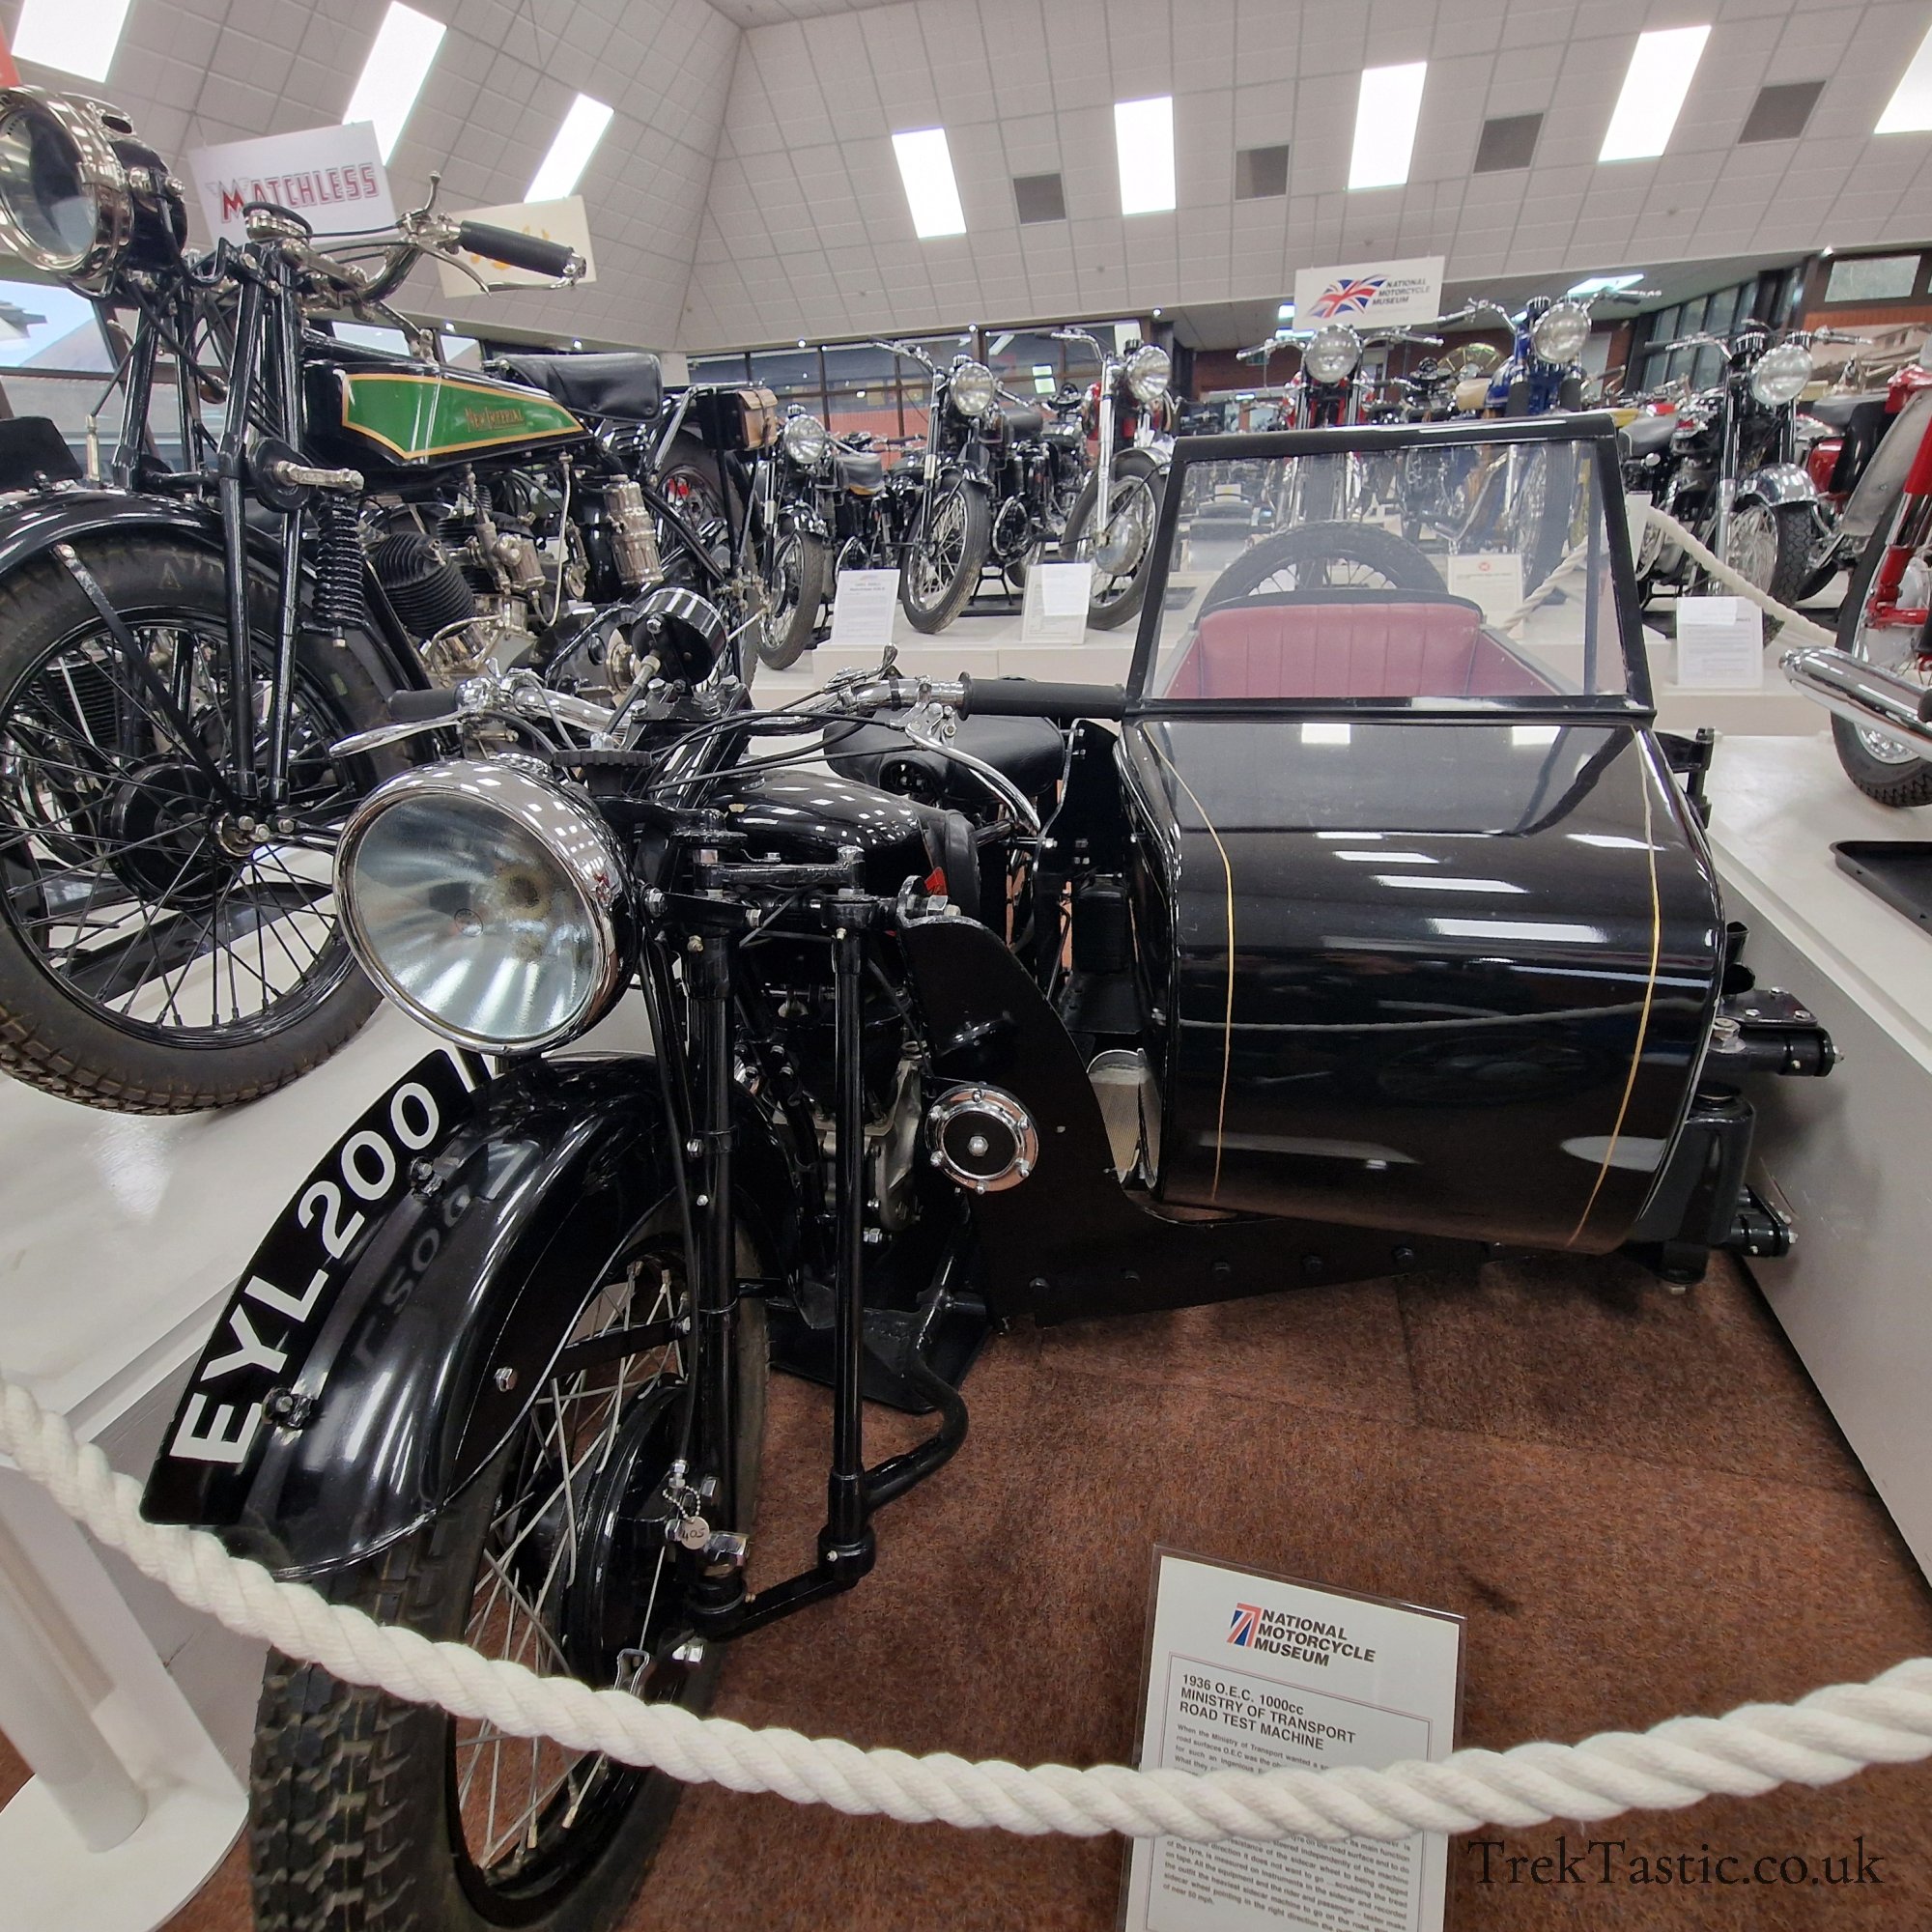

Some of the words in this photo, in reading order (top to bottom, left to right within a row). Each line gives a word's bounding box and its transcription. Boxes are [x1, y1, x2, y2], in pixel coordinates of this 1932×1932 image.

[218, 162, 379, 223] MATCHLESS
[1372, 297, 1409, 306] MUSEUM
[1378, 286, 1431, 298] MOTORCYCLE
[1386, 278, 1427, 289] NATIONAL
[1259, 1623, 1376, 1662] MOTORCYCLE
[1263, 1609, 1348, 1640] NATIONAL
[1254, 1637, 1330, 1666] MUSEUM
[1182, 1674, 1211, 1690] 1936
[1215, 1682, 1254, 1703] O.E.C.
[1260, 1694, 1304, 1716] 1000cc
[1179, 1701, 1218, 1720] ROAD
[1222, 1712, 1257, 1731] TEST
[1260, 1723, 1324, 1750] MACHINE
[1180, 1688, 1243, 1713] MINISTRY
[1247, 1705, 1265, 1719] OF
[1270, 1710, 1356, 1744] TRANSPORT
[1175, 1755, 1191, 1766] What
[1193, 1760, 1208, 1772] they
[1177, 1735, 1192, 1745] road
[1193, 1740, 1221, 1752] surfaces
[1244, 1754, 1257, 1763] was
[1260, 1758, 1270, 1767] the
[1178, 1724, 1196, 1735] When
[1199, 1729, 1208, 1738] the
[1212, 1733, 1237, 1747] Ministry
[1251, 1745, 1283, 1759] Transport
[1286, 1755, 1311, 1766] wanted
[1188, 1749, 1205, 1758] such
[1301, 1848, 1350, 1868] independently
[1364, 1866, 1376, 1875] the
[1378, 1871, 1408, 1885] machine
[1329, 1845, 1346, 1855] road
[1348, 1851, 1374, 1863] surface
[1360, 1843, 1378, 1853] main
[1380, 1847, 1409, 1862] function
[1165, 1861, 1176, 1870] the
[1199, 1872, 1209, 1881] the
[1211, 1876, 1239, 1890] heaviest
[1243, 1887, 1267, 1899] sidecar
[1270, 1895, 1301, 1910] machine
[1338, 1916, 1350, 1925] the
[1172, 1887, 1186, 1895] near
[1176, 1842, 1186, 1851] the
[1214, 1856, 1248, 1870] measured
[1262, 1870, 1303, 1888] instruments
[1316, 1887, 1326, 1895] the
[1329, 1891, 1354, 1903] sidecar
[1358, 1900, 1371, 1909] and
[1375, 1905, 1406, 1919] recorded
[1206, 1862, 1216, 1871] the
[1218, 1867, 1254, 1884] equipment
[1256, 1880, 1268, 1889] and
[1270, 1884, 1282, 1892] the
[1284, 1888, 1299, 1897] rider
[1302, 1893, 1315, 1903] and
[1211, 1843, 1240, 1858] direction
[1251, 1856, 1267, 1865] does
[1271, 1861, 1282, 1870] not
[1285, 1866, 1301, 1876] want
[1375, 1892, 1386, 1901] the
[1389, 1897, 1407, 1908] tread
[1276, 1852, 1288, 1861] the
[1291, 1857, 1315, 1868] sidecar
[1320, 1865, 1340, 1876] wheel
[1354, 1875, 1374, 1888] being
[1378, 1883, 1407, 1896] dragged
[1164, 1873, 1188, 1885] sidecar
[1191, 1882, 1210, 1891] wheel
[1213, 1889, 1241, 1904] pointing
[1254, 1900, 1264, 1910] the
[1267, 1906, 1284, 1917] right
[1288, 1912, 1319, 1927] direction
[1321, 1922, 1333, 1931] the
